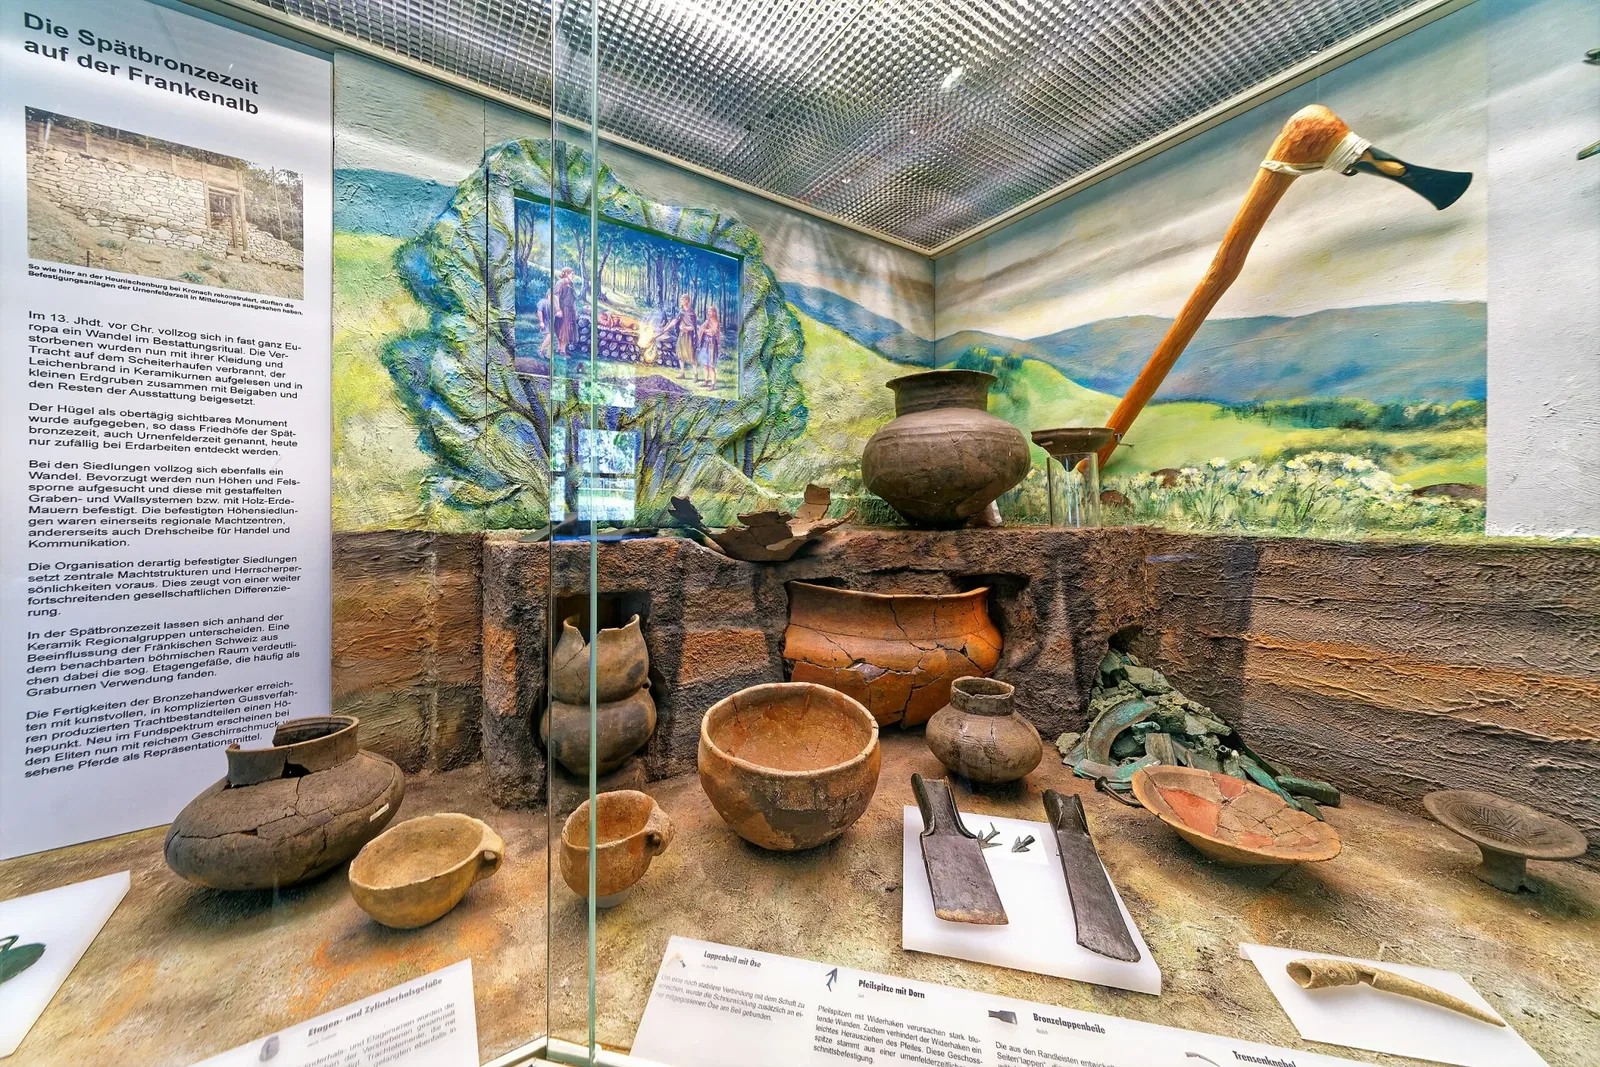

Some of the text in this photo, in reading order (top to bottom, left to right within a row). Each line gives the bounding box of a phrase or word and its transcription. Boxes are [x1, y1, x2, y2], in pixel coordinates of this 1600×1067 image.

[24, 12, 259, 94] Die Spätbronzezeit
[24, 40, 259, 115] auf der Frankenalb
[28, 270, 116, 288] Befestigungsanlagen
[132, 286, 188, 299] Urnenfelderzeit
[199, 295, 241, 307] Mitteleuropa
[59, 268, 75, 276] hier
[105, 275, 168, 291] Heunischenburg
[182, 287, 212, 296] Kronach
[260, 298, 283, 307] dürften
[29, 310, 301, 351] Im 13. Jhdt. vor Chr. vollzog sich in fast ganz Eu-
[28, 334, 283, 368] storbenen wurden nun mit ihrer Kleidung und
[29, 356, 303, 390] Leichenbrand in Keramikurnen aufgelesen und in
[29, 402, 287, 427] Der Hügel als obertägig sichtbares Monument
[29, 425, 298, 447] bronzezeit, auch Urnenfelderzeit genannt, heute
[28, 494, 294, 505] Graben- und Wallsystemen bzw. mit Holz-Erde-
[28, 526, 290, 536] andererseits auch Drehscheibe für Handel und
[28, 538, 130, 548] Kommunikation.
[28, 555, 297, 572] Die Organisation derartig befestigter Siedlungen
[28, 582, 111, 594] sönlichkeiten
[162, 579, 187, 587] Dies
[190, 577, 220, 587] zeugt
[244, 575, 269, 583] einer
[271, 574, 301, 582] weiter
[28, 613, 284, 639] In der Spätbronzezeit lassen sich anhand der
[27, 648, 118, 663] Beeinflussung
[121, 645, 141, 654] der
[144, 639, 212, 651] Fränkischen
[215, 634, 258, 645] Schweiz
[26, 679, 293, 719] Die Fertigkeiten der Bronzehandwerker erreich-
[25, 756, 50, 766] den
[54, 750, 90, 761] Eliten
[95, 746, 118, 755] nun
[122, 741, 140, 751] mit
[143, 735, 188, 748] reichem
[704, 951, 761, 968] Lappenbeil mit Öse
[858, 980, 925, 998] Pfeilspitze mit Dorn
[308, 978, 442, 1037] Etagen- und Zylinderhalsgefäße
[817, 1015, 833, 1024] tende
[835, 1018, 862, 1029] Wunden.
[863, 1024, 885, 1034] Zudem
[886, 1030, 918, 1042] verhindert
[931, 1038, 970, 1052] Widerhaken
[818, 1005, 851, 1018] Pfeilspitzen
[867, 1015, 903, 1028] Widerhaken
[907, 1024, 945, 1036] verursachen
[949, 1032, 965, 1040] stark
[968, 1035, 981, 1043] blu-
[1033, 1013, 1105, 1034] Bronzelappenbeile
[815, 1025, 983, 1064] leichtes Herausziehen des Pfeiles. Diese Geschoss-
[996, 1042, 1078, 1064] Die aus den Randleisten
